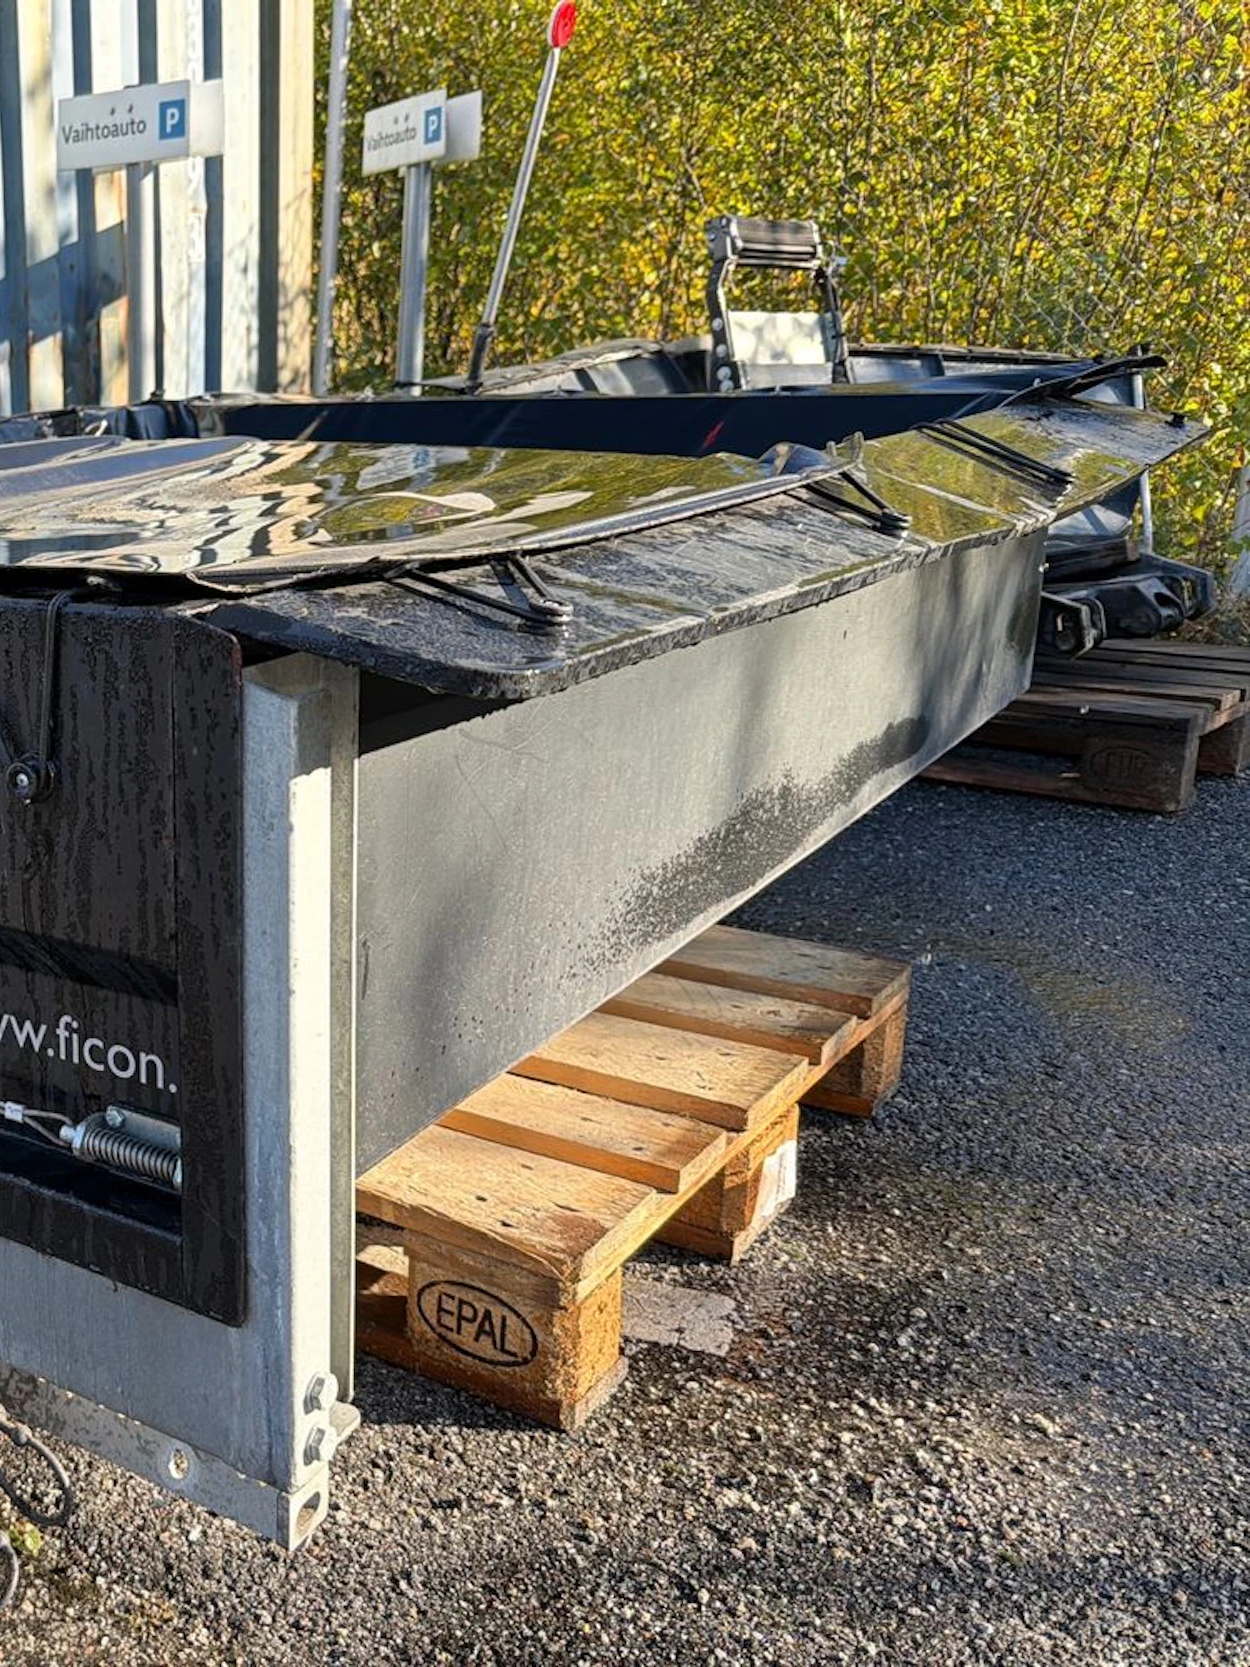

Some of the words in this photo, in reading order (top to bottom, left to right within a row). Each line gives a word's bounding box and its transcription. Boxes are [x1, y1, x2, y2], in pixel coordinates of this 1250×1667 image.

[62, 118, 147, 145] Vaihtoauto
[165, 107, 180, 134] P
[427, 114, 439, 139] P
[435, 1292, 519, 1358] EPAL
